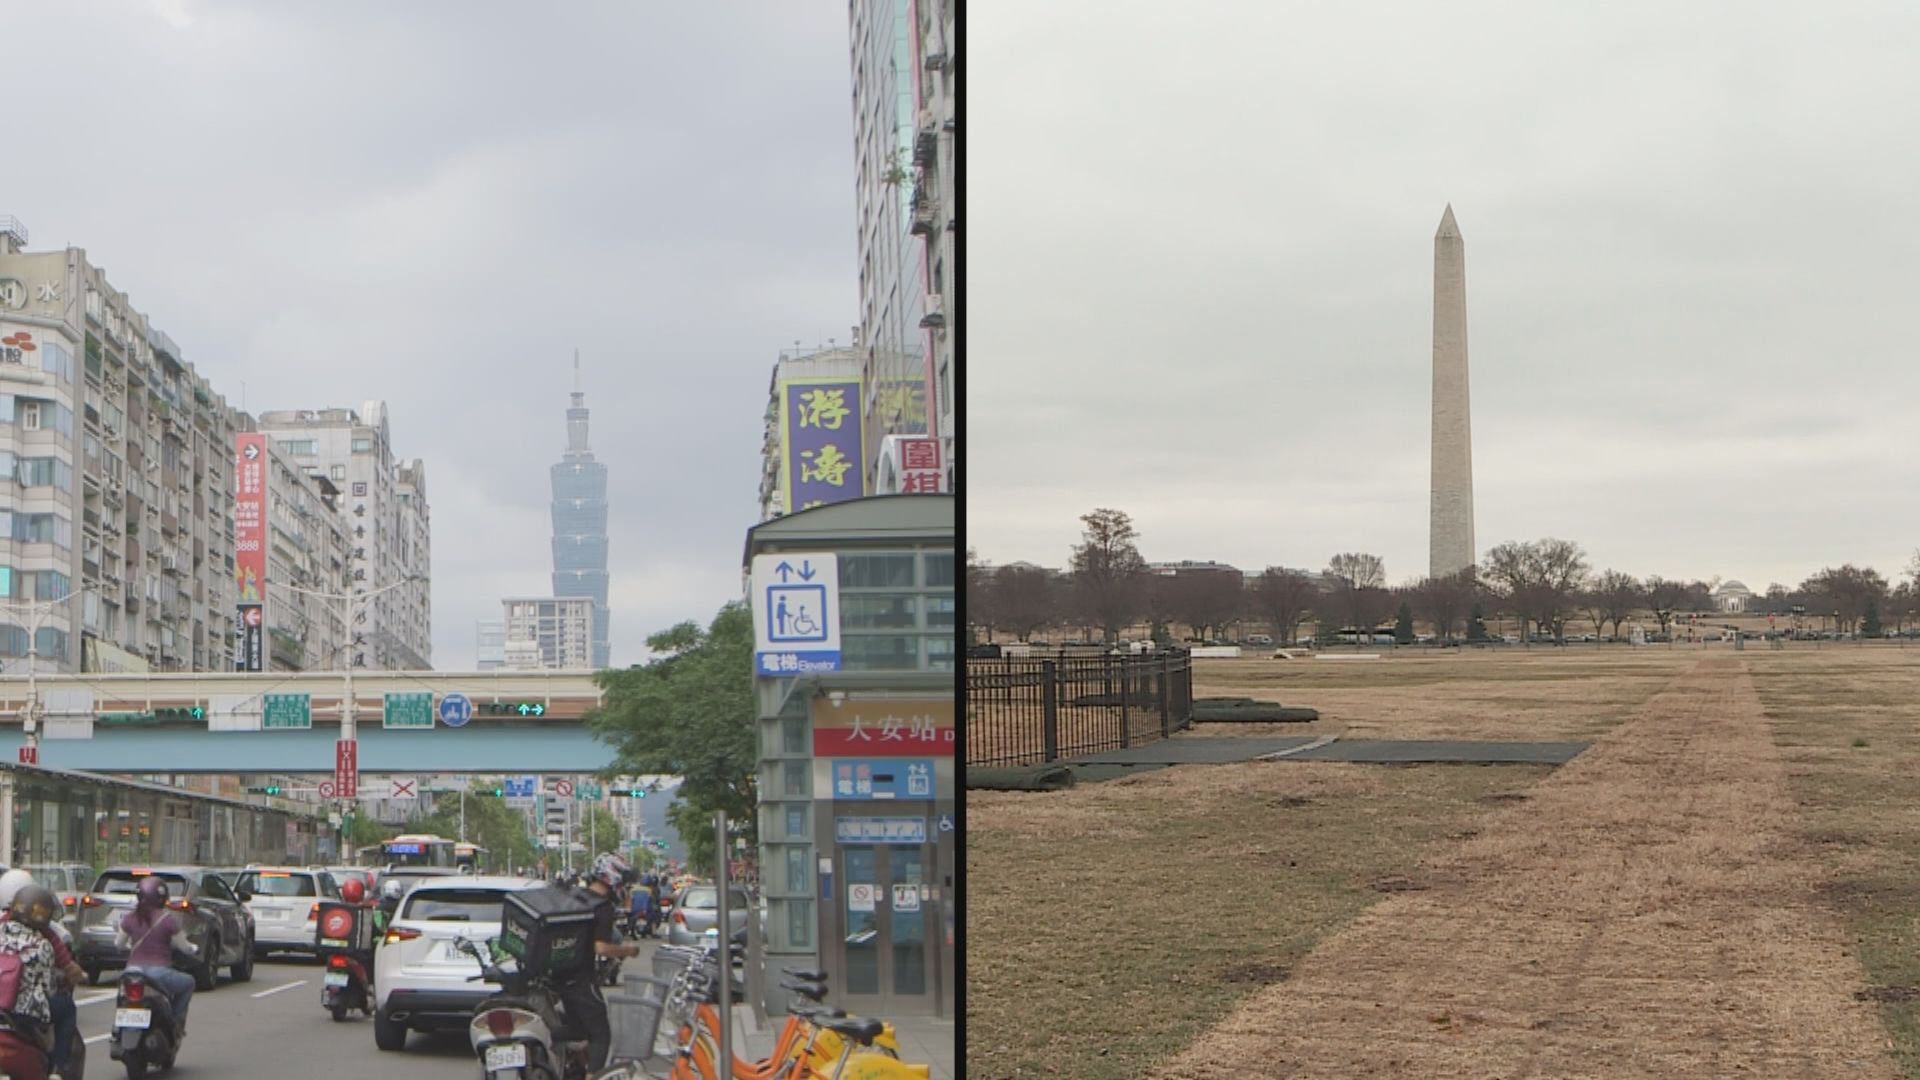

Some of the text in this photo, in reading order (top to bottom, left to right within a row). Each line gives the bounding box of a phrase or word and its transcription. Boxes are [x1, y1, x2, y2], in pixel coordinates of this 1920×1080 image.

[762, 654, 797, 671] 電梯
[798, 659, 836, 671] Elevator
[846, 714, 936, 741] 大安站
